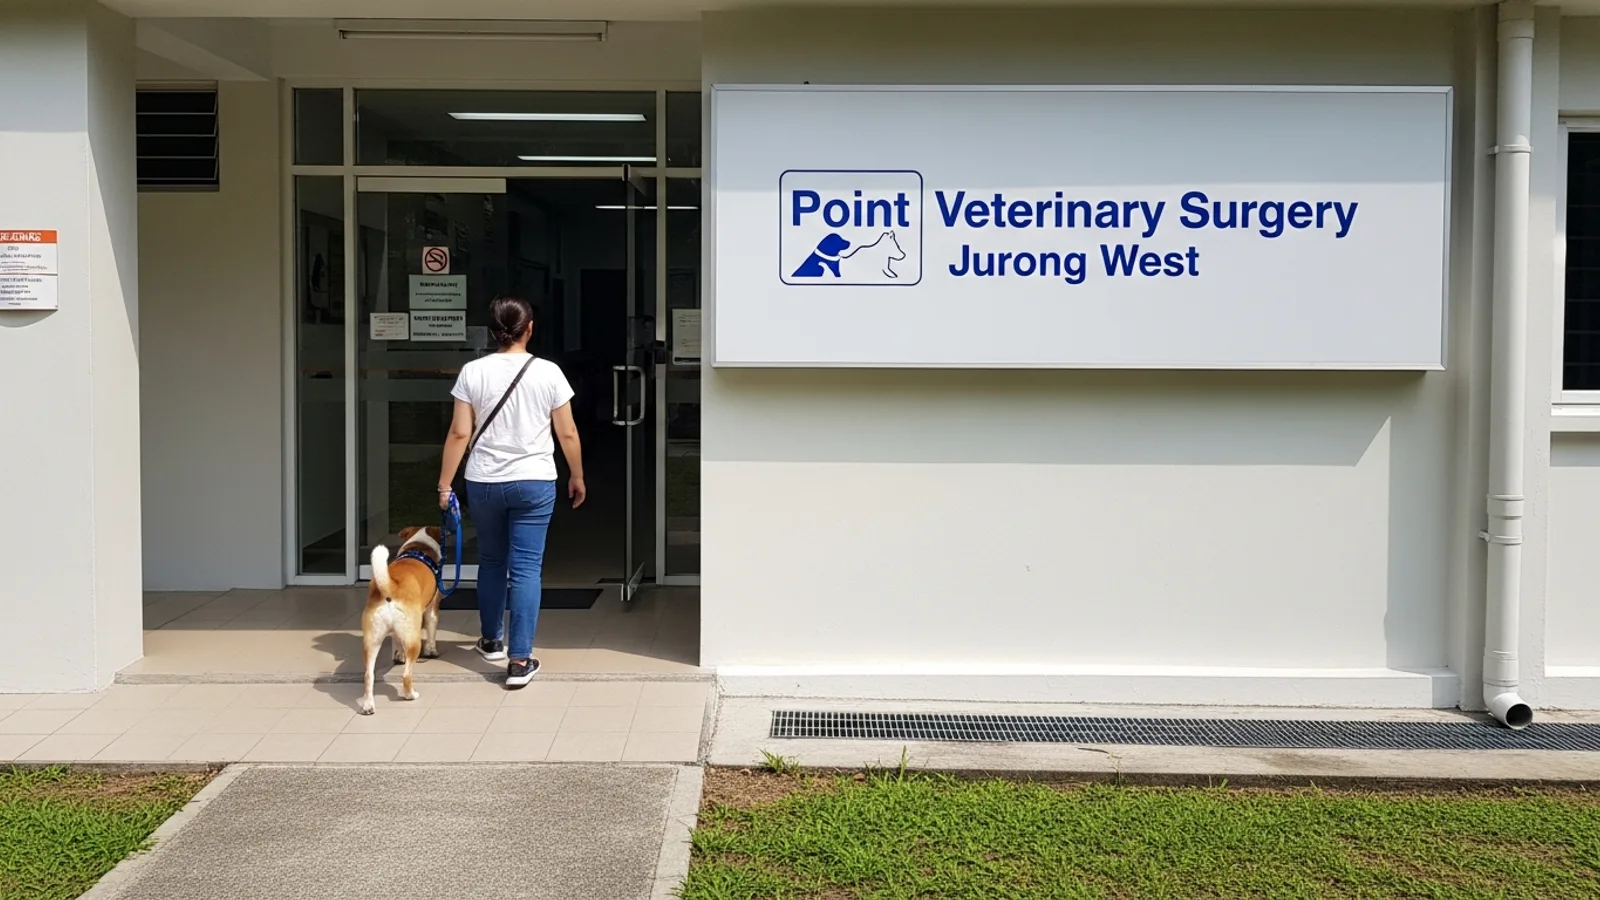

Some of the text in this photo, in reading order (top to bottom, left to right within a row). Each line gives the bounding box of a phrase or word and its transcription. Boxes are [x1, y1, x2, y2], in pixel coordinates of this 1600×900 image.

[792, 190, 1357, 238] Point Veterinary Surgery
[949, 244, 1198, 284] Jurong West
